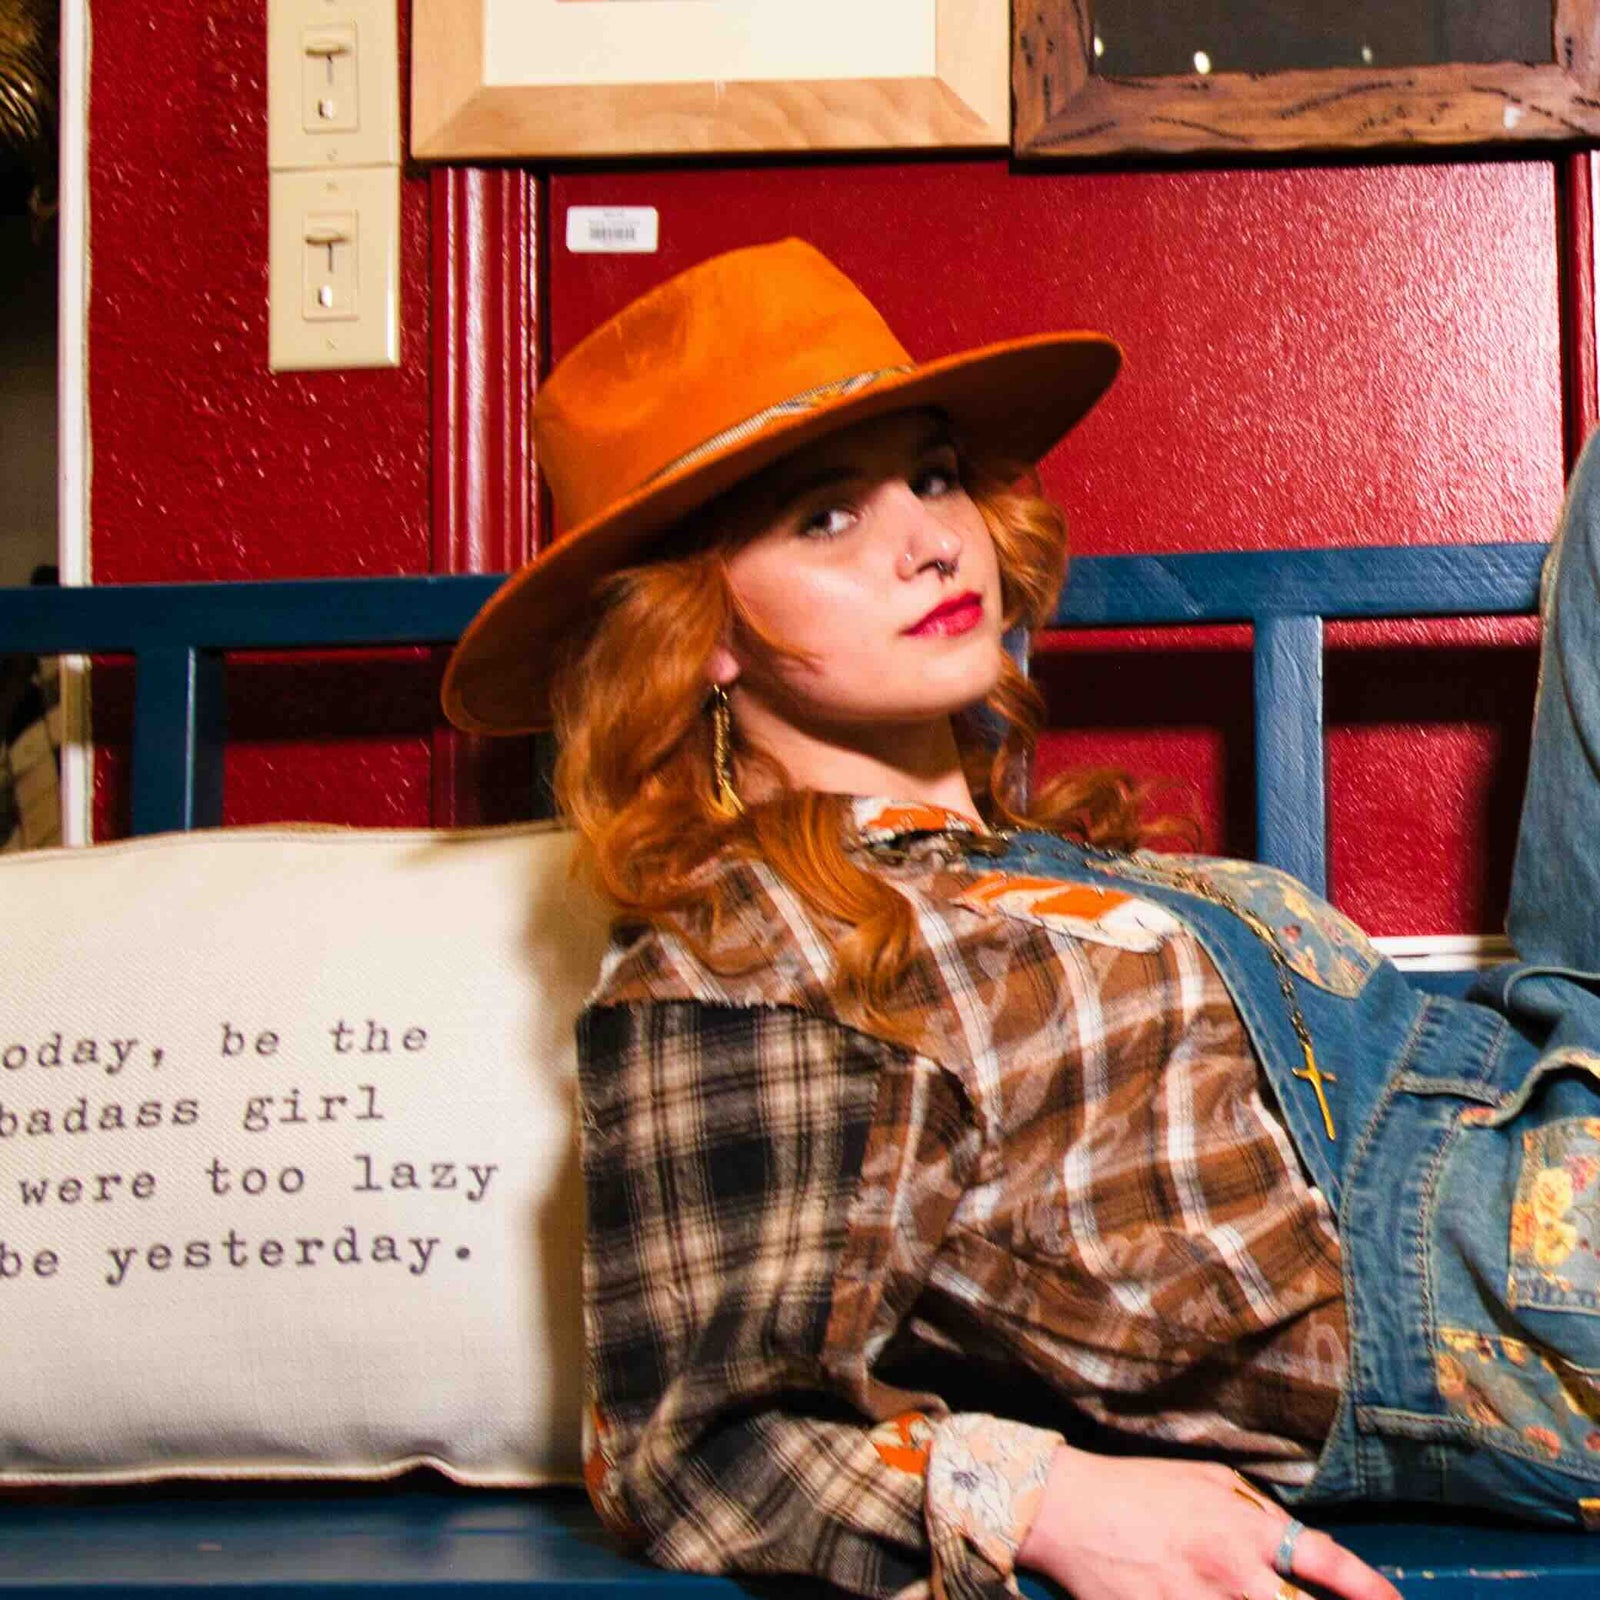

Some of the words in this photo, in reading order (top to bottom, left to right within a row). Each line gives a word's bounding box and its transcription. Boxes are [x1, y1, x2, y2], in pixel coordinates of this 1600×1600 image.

[221, 1022, 280, 1057] be
[329, 1020, 428, 1054] the
[0, 1097, 199, 1139] badass
[242, 1084, 384, 1133] girl
[18, 1171, 156, 1206] were
[205, 1157, 305, 1196] too
[353, 1154, 498, 1203] lazy
[0, 1241, 59, 1279] be
[105, 1226, 471, 1287] yesterday.
